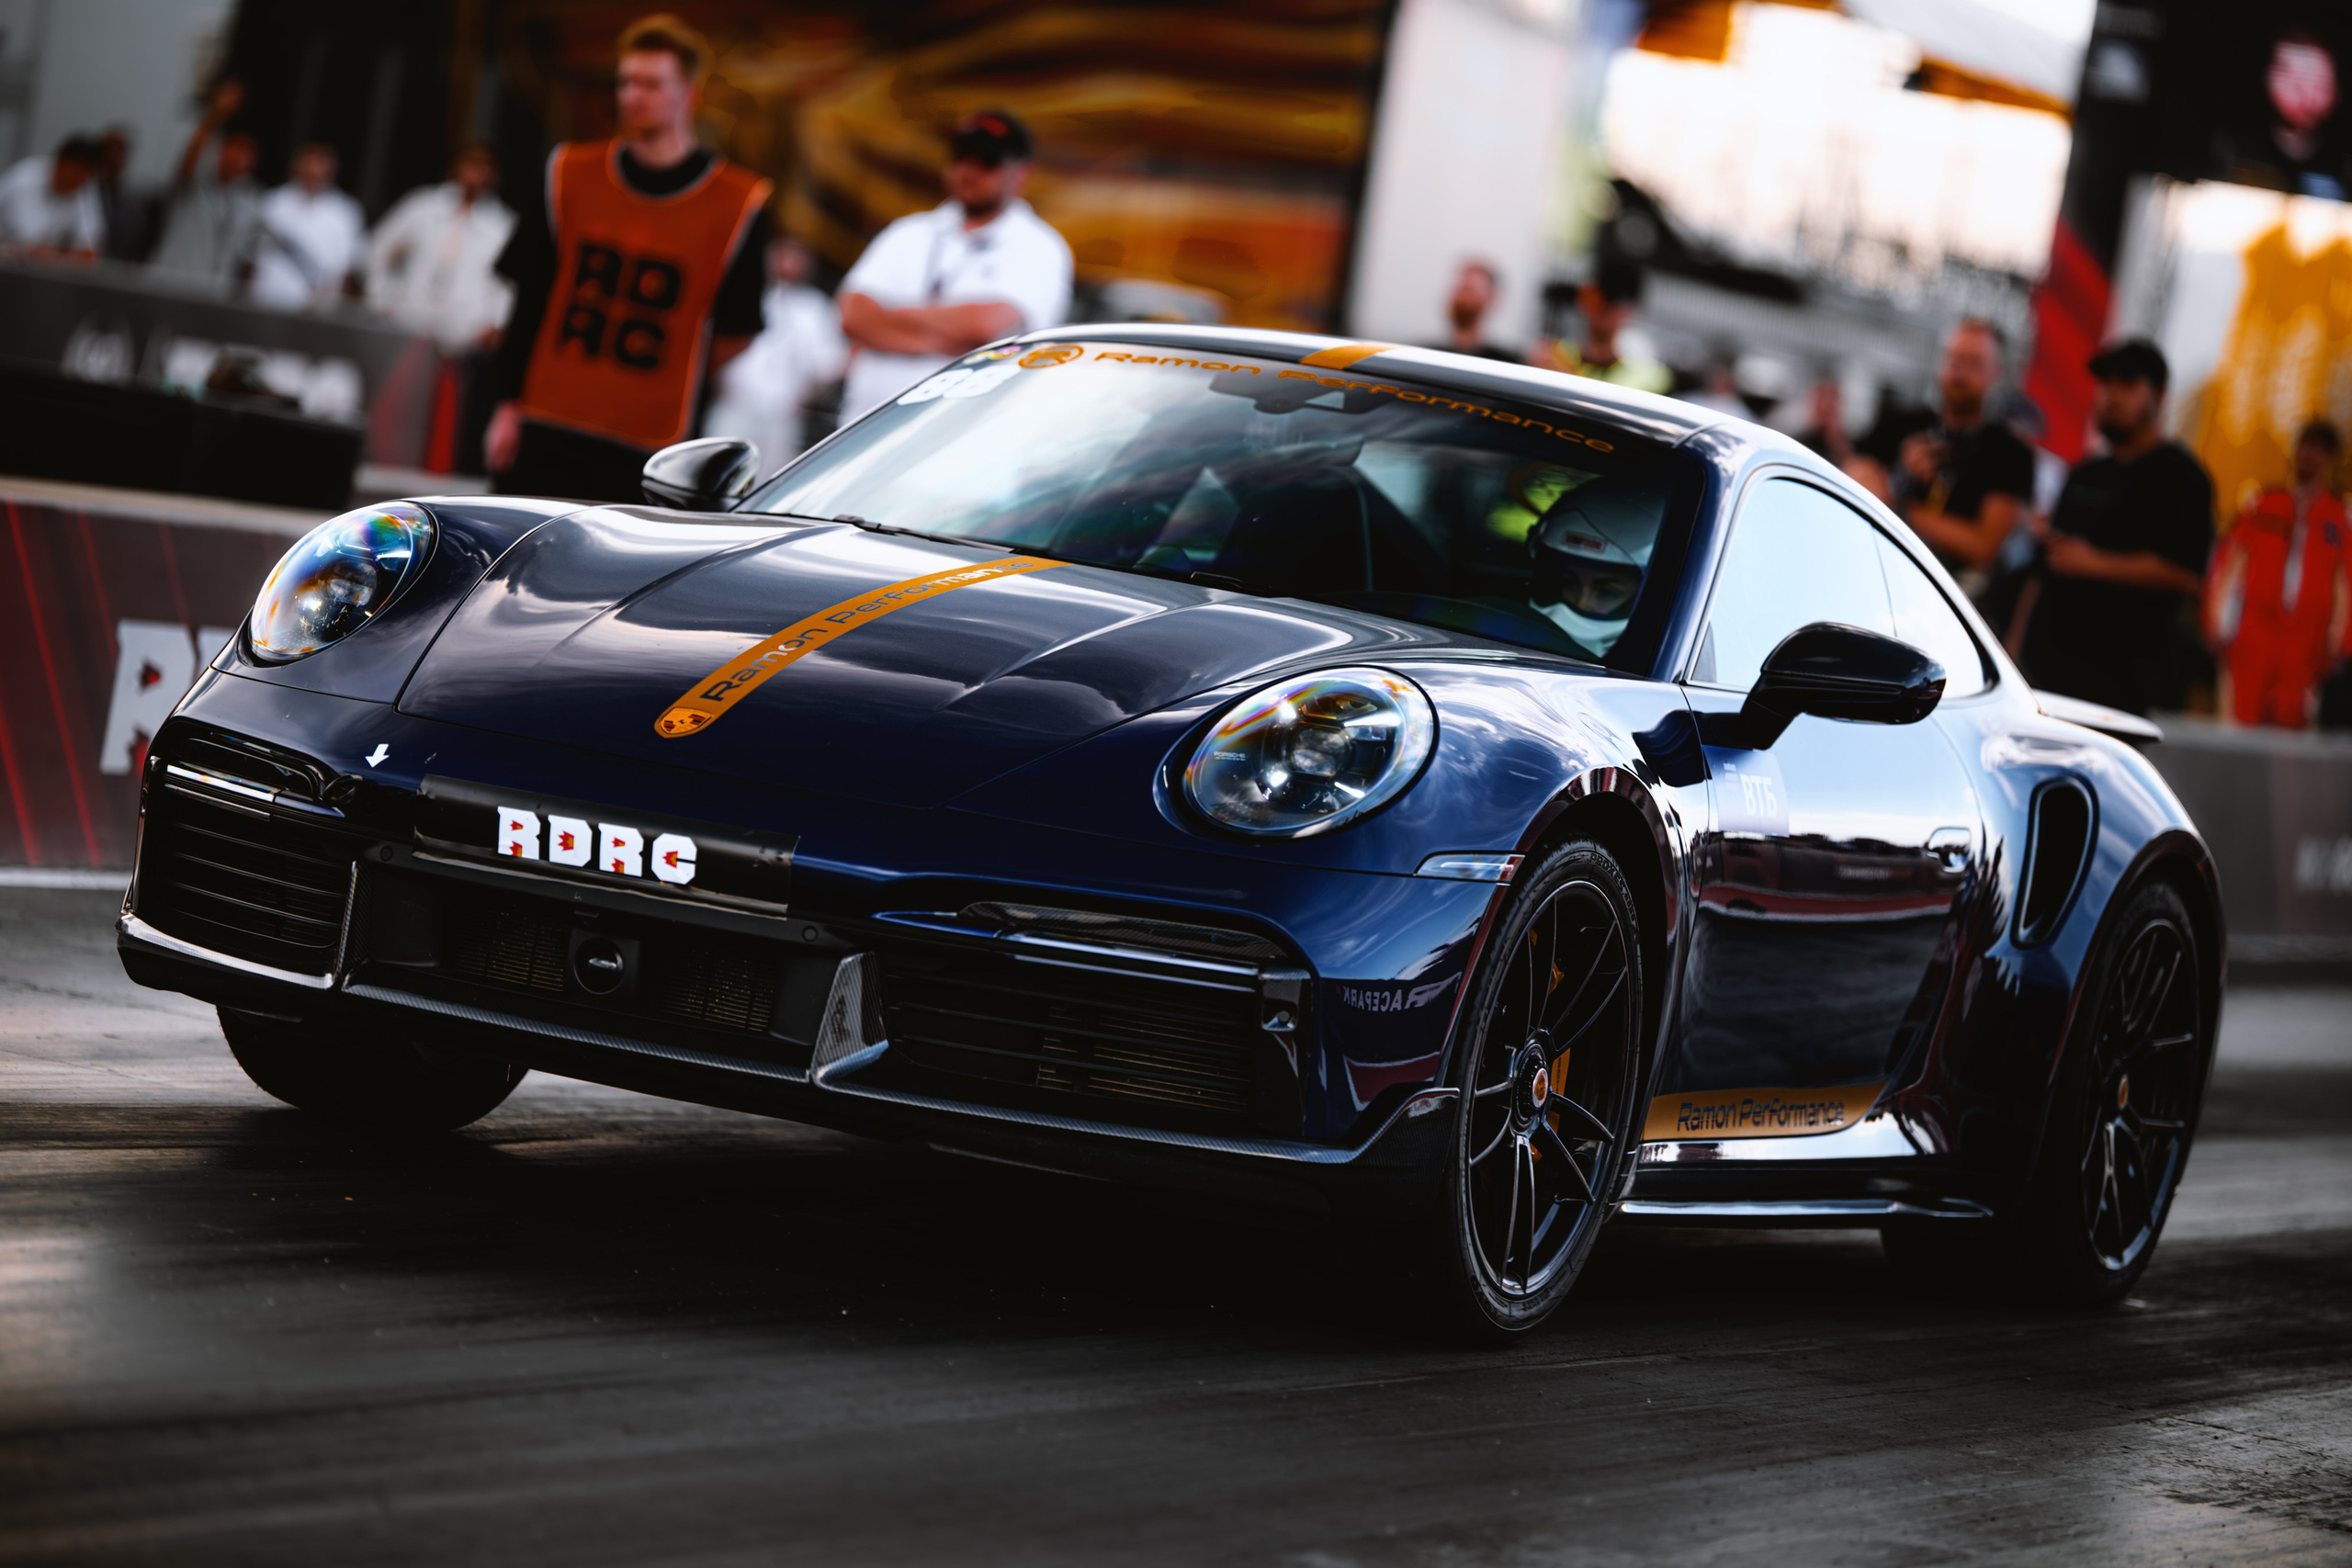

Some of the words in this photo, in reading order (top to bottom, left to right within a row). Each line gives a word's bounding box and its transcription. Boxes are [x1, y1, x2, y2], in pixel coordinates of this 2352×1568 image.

[575, 244, 681, 310] RD
[560, 303, 665, 369] RC
[1094, 351, 1261, 376] Ramon
[700, 627, 829, 702] Ramon
[497, 806, 697, 885] RDRC
[1677, 1102, 1736, 1132] Ramon
